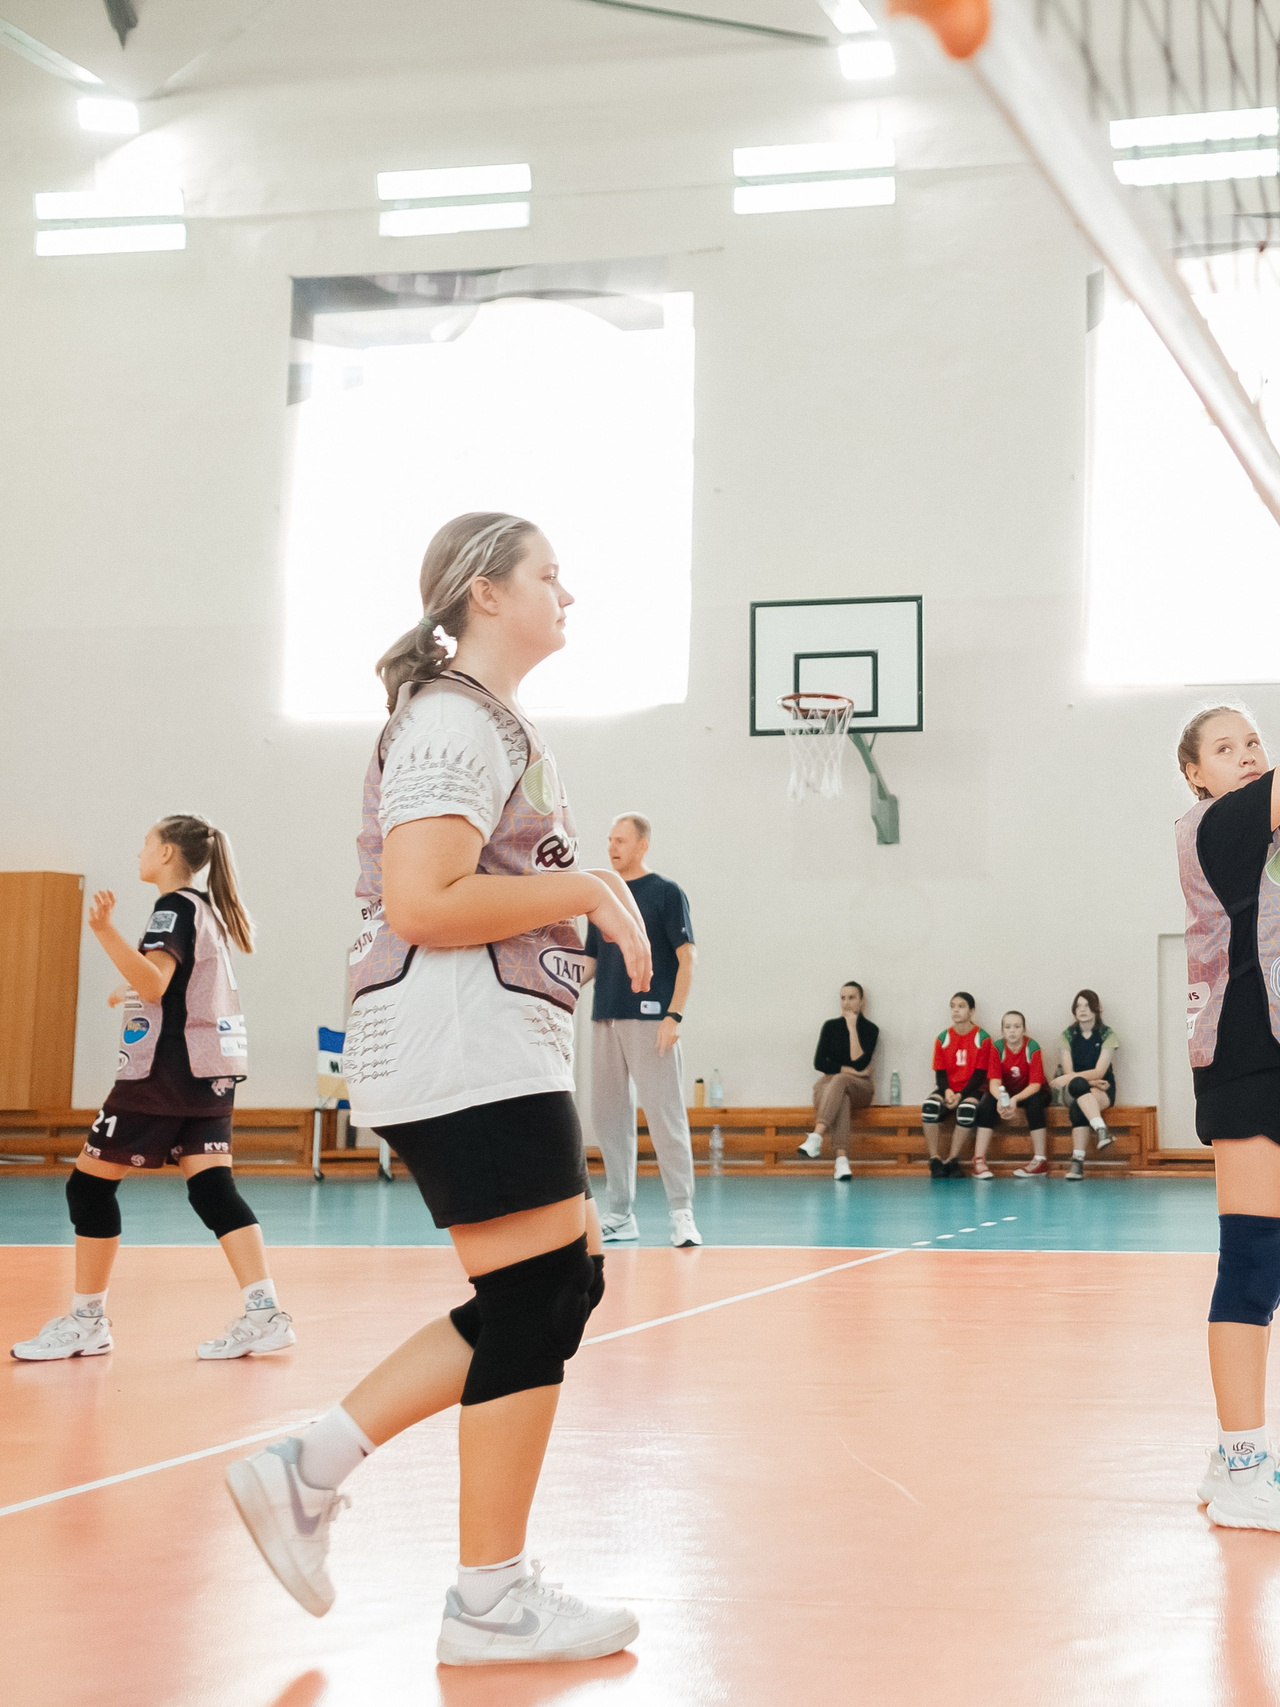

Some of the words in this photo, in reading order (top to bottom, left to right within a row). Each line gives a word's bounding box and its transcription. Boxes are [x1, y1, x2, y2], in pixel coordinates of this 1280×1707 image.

[91, 1109, 118, 1138] 21
[203, 1142, 230, 1151] KVS
[1228, 1450, 1269, 1468] KVS
